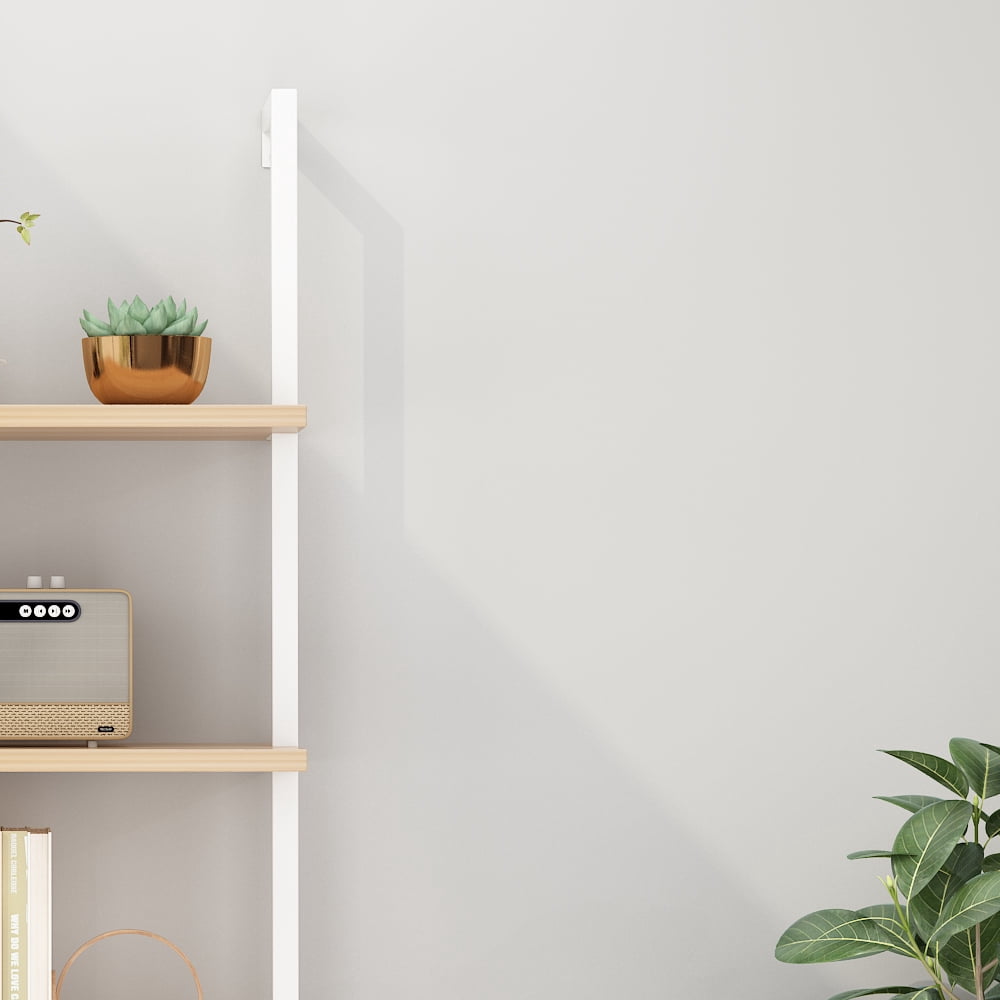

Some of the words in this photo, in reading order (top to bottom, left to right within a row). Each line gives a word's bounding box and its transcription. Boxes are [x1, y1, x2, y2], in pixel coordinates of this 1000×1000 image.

[10, 914, 19, 935] WHY
[10, 937, 19, 950] DO
[10, 952, 19, 967] WE
[10, 969, 19, 991] LOVE
